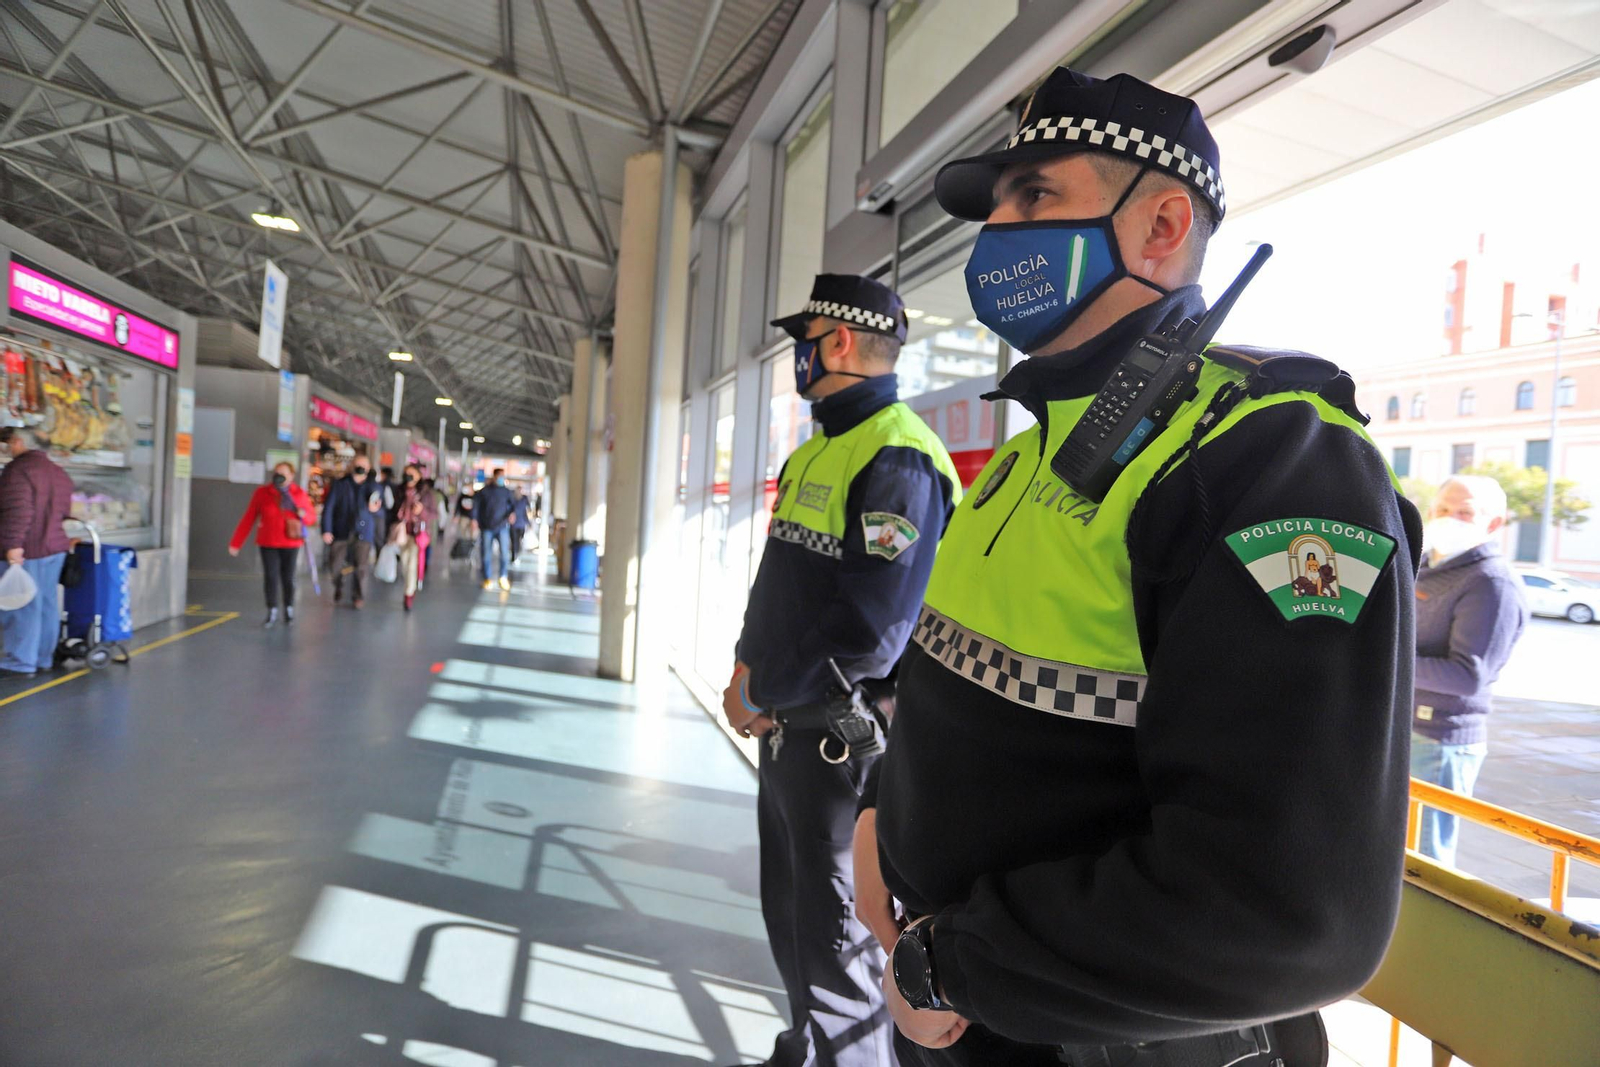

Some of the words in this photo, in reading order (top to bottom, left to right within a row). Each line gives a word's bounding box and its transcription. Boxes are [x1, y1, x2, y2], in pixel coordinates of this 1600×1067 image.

[1014, 272, 1047, 290] LOCAL
[996, 282, 1055, 311] HUELVA
[1000, 314, 1016, 323] A.C.
[1017, 298, 1059, 319] CHARLY-6
[1145, 344, 1169, 357] MOTOROLA
[1240, 520, 1314, 543] POLICIA
[1321, 521, 1376, 546] LOCAL
[1292, 602, 1346, 616] HUELVA
